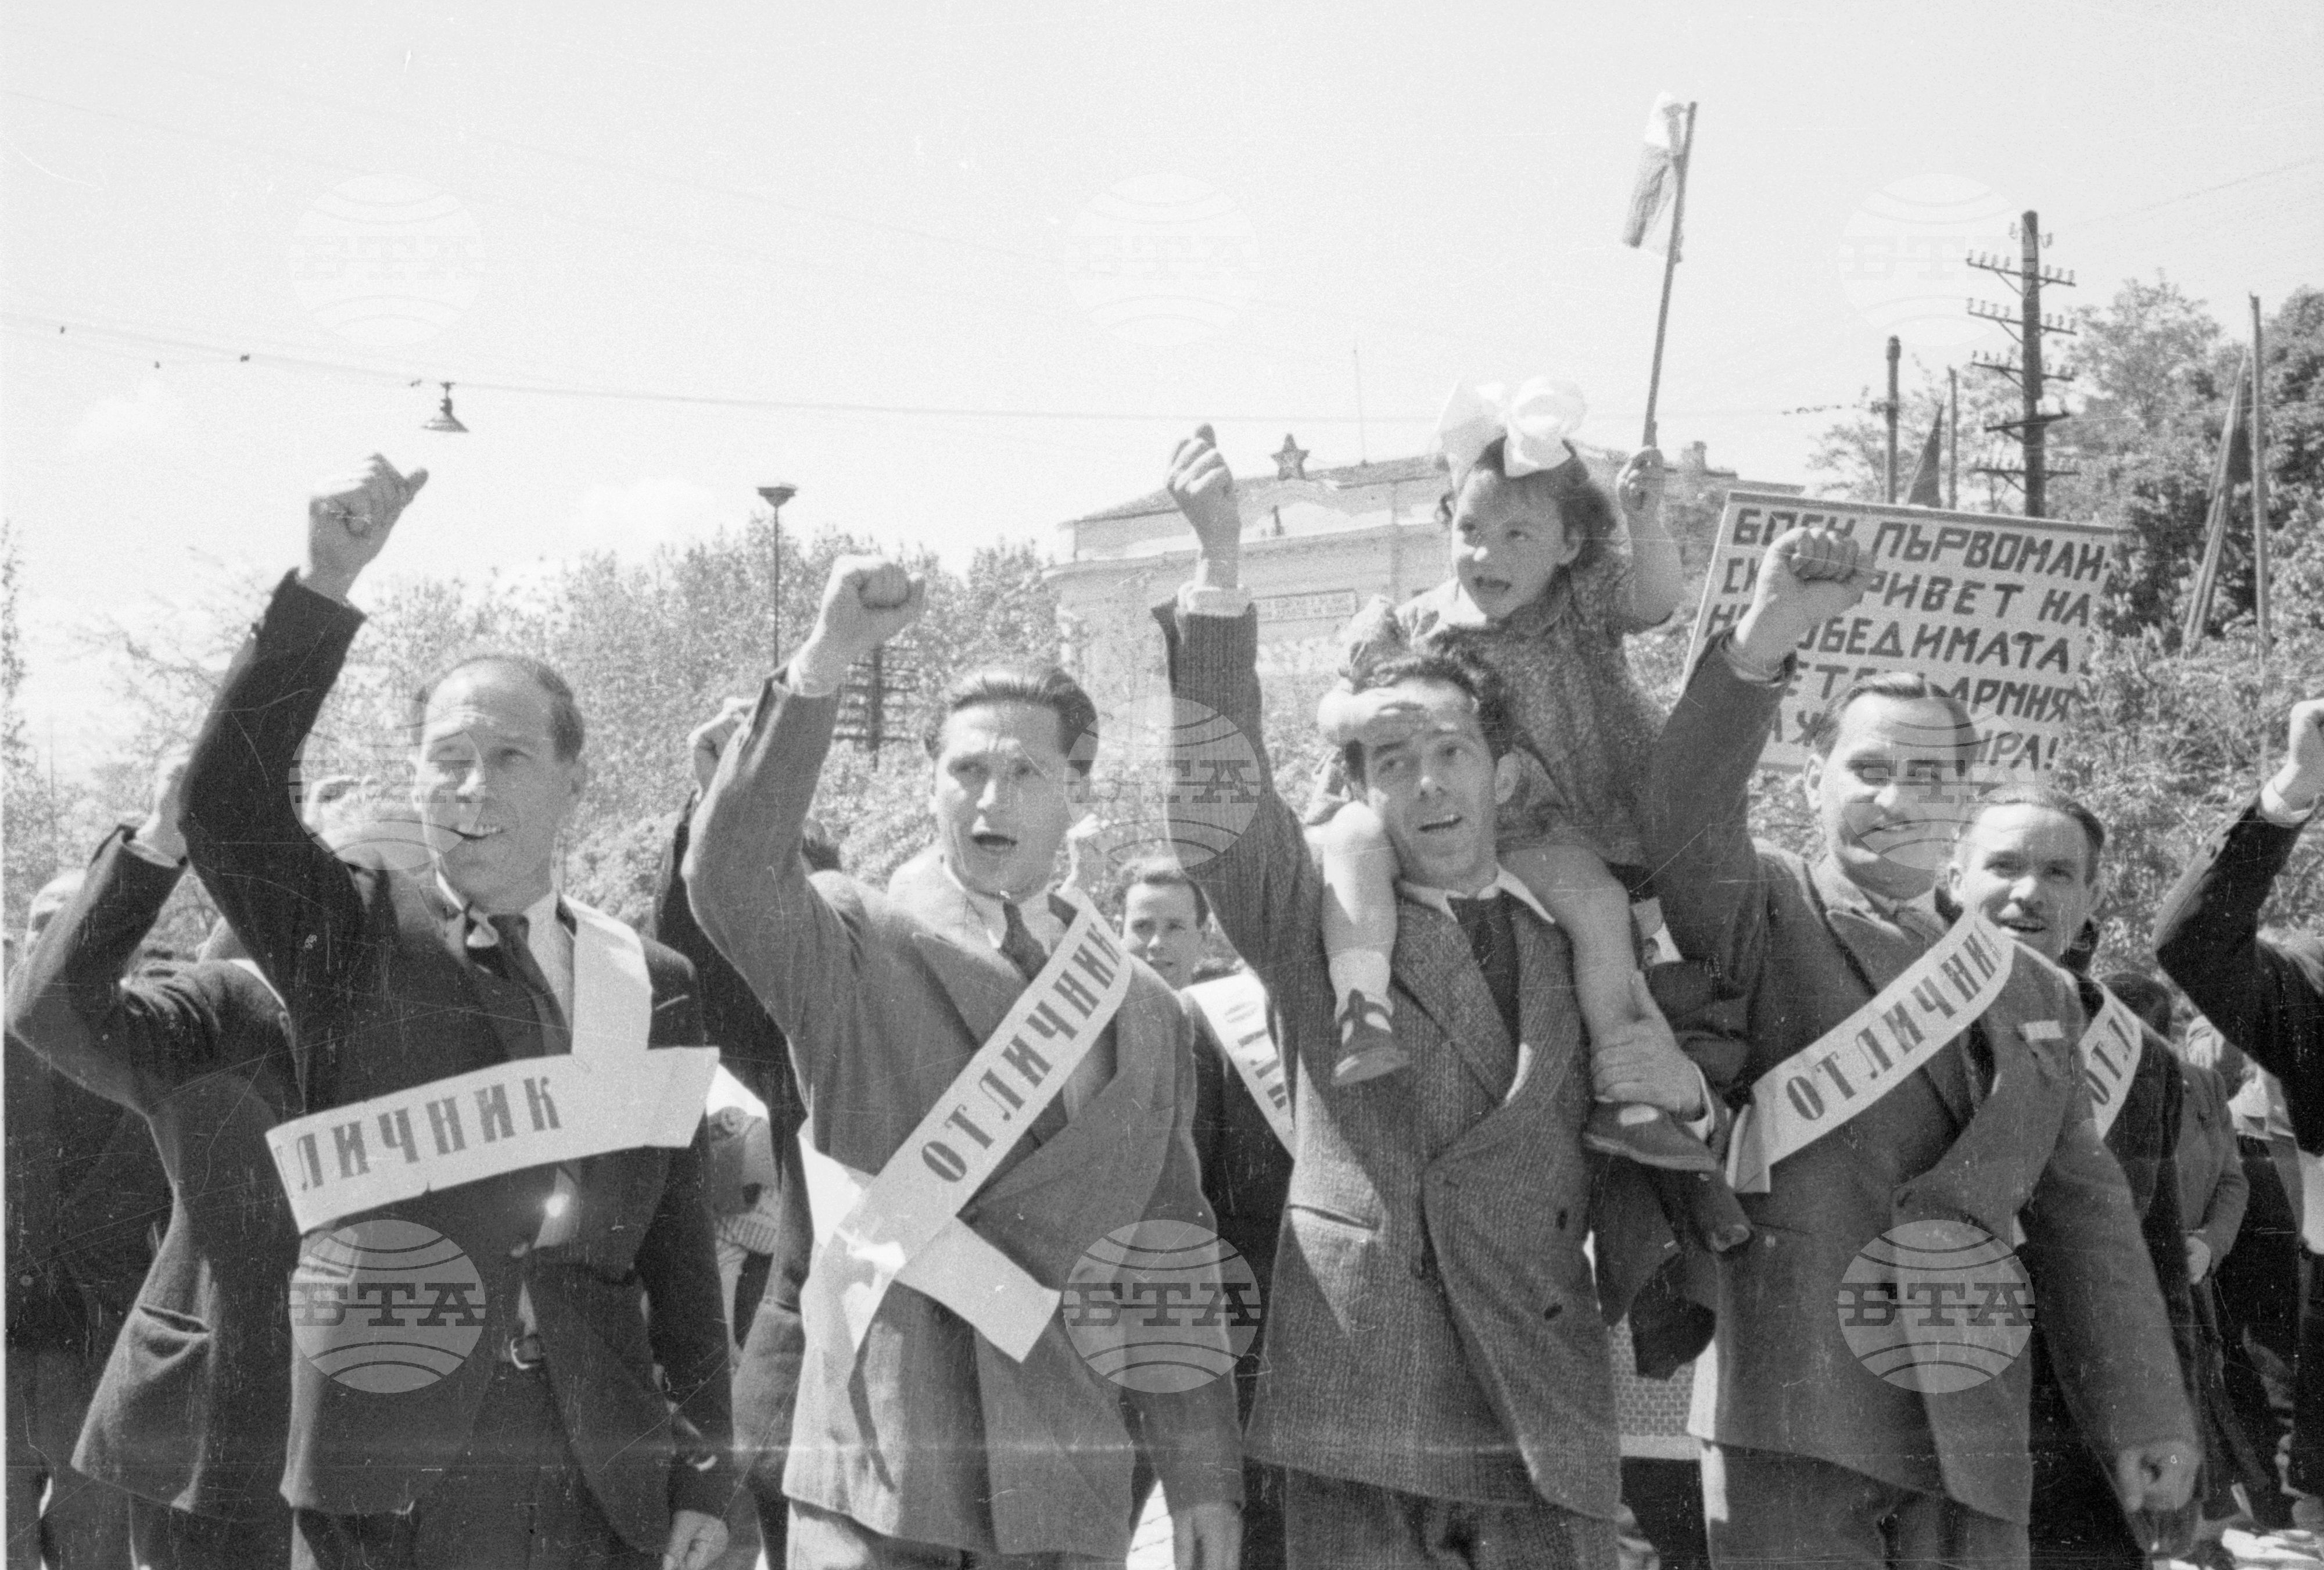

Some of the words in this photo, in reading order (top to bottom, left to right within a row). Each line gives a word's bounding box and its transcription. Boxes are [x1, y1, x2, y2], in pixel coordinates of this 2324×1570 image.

[1860, 570, 2024, 618] РИВЕТ
[2038, 589, 2090, 627] НА
[275, 1076, 561, 1191] ЛИЧНИК
